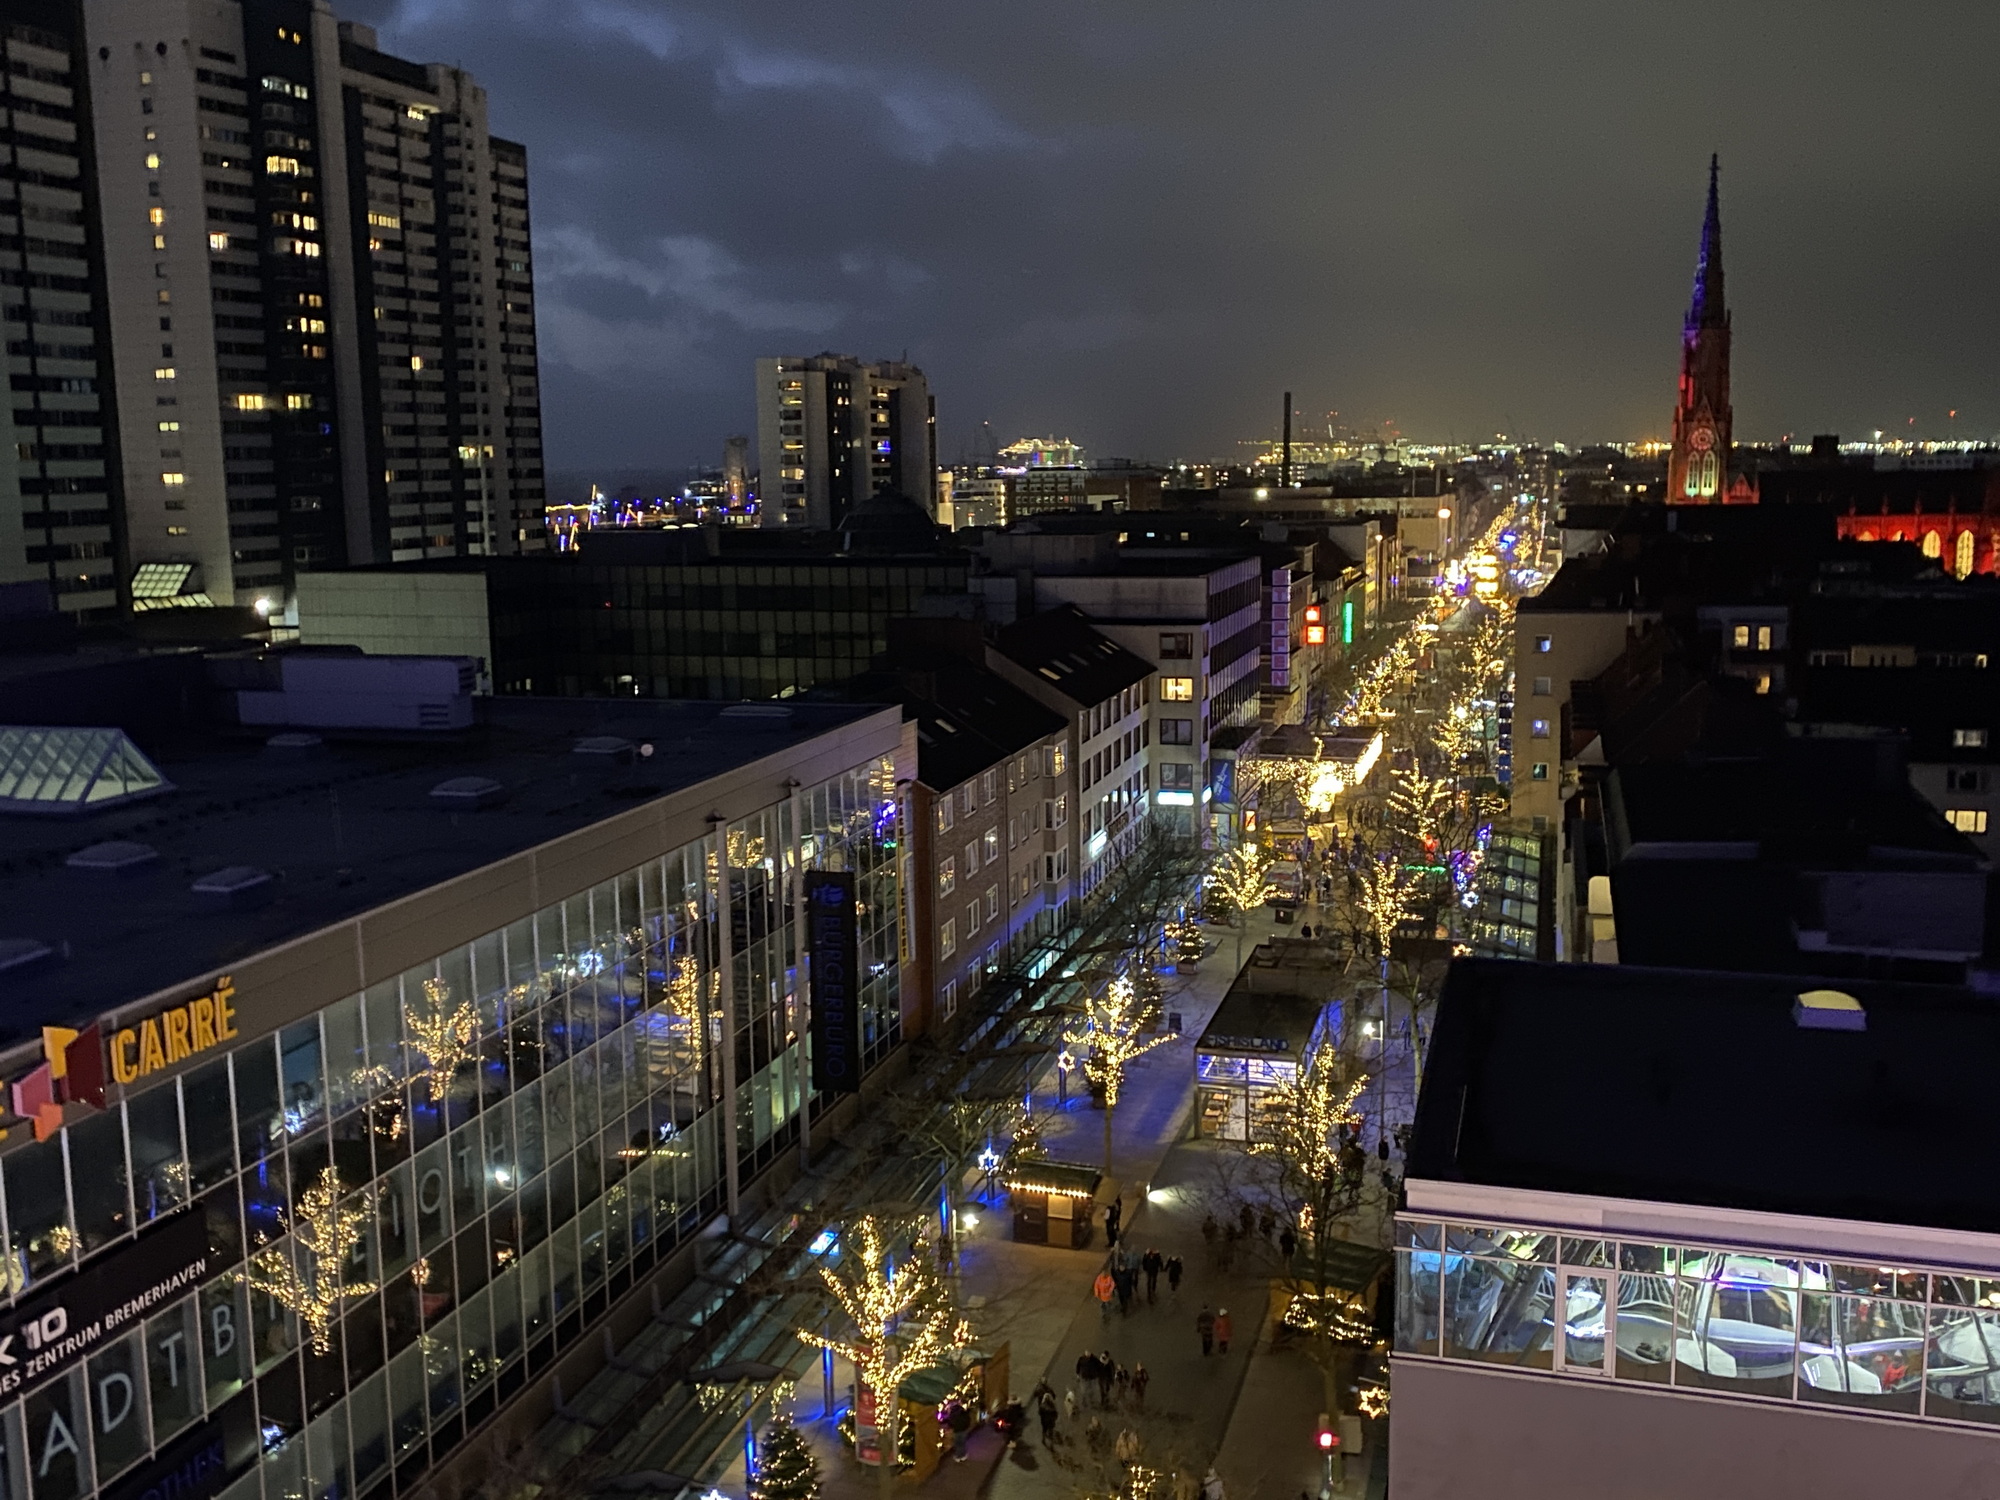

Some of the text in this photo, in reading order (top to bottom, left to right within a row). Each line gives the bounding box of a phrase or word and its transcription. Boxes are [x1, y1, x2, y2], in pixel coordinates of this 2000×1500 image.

[823, 916, 848, 1077] BÜRGERBÜRO
[0, 1258, 206, 1395] ES ZENTRUM BREMERHAVEN
[22, 1306, 67, 1350] 10
